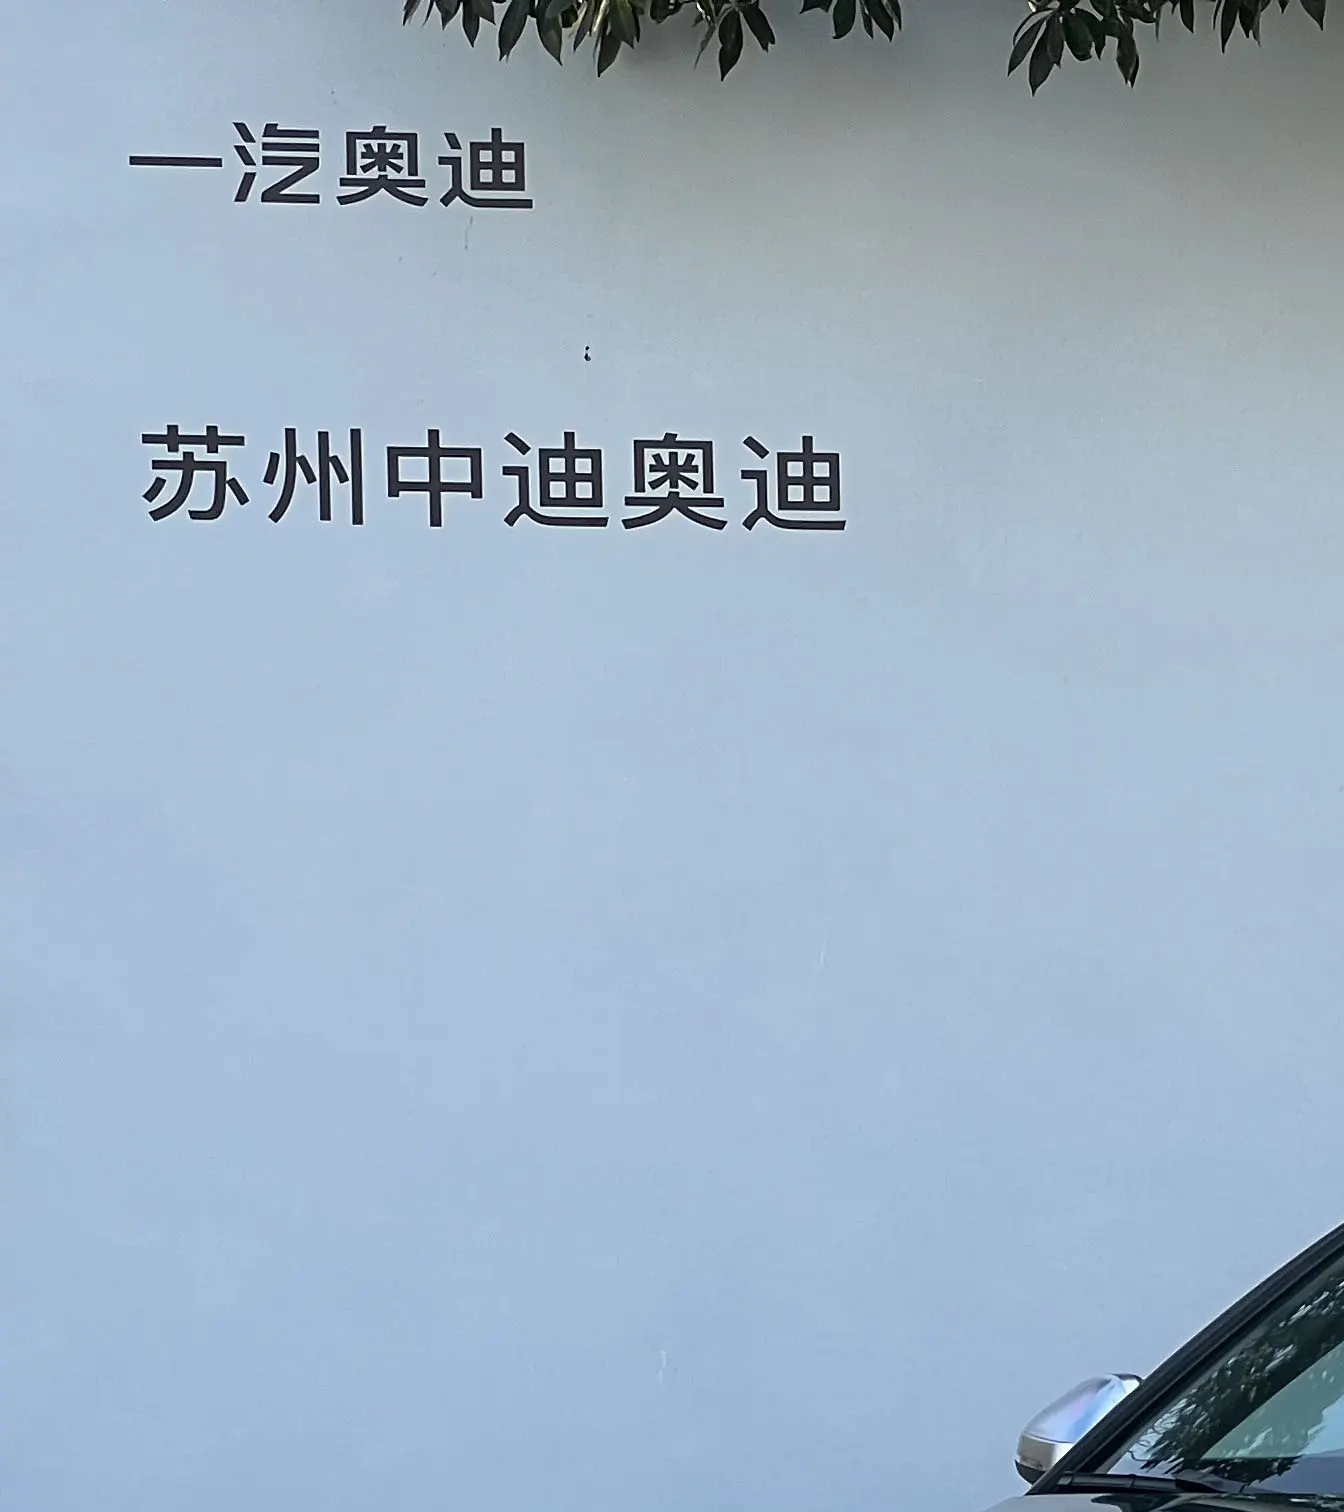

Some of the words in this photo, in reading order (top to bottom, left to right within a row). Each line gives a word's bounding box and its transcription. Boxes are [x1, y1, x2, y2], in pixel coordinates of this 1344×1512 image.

[128, 120, 534, 209] 一汽奥迪
[140, 423, 848, 532] 苏州中迪奥迪
